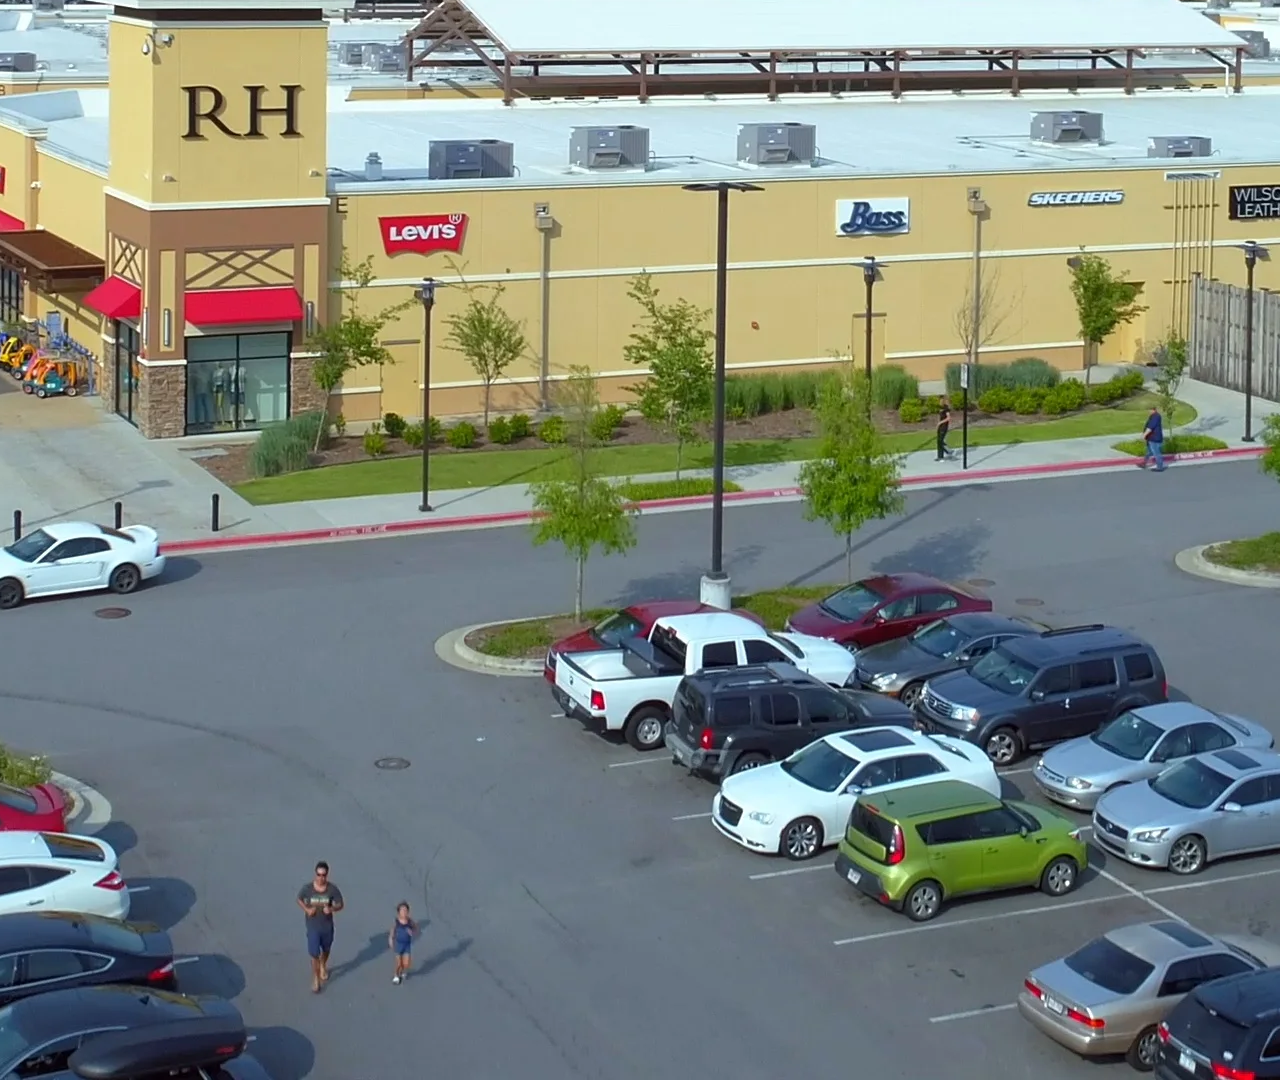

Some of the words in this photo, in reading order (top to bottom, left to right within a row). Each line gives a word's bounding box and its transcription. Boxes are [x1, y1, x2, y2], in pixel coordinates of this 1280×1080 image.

[180, 84, 303, 139] RH
[336, 197, 348, 213] E
[1029, 191, 1125, 205] SKECHERS
[840, 201, 907, 233] Bass
